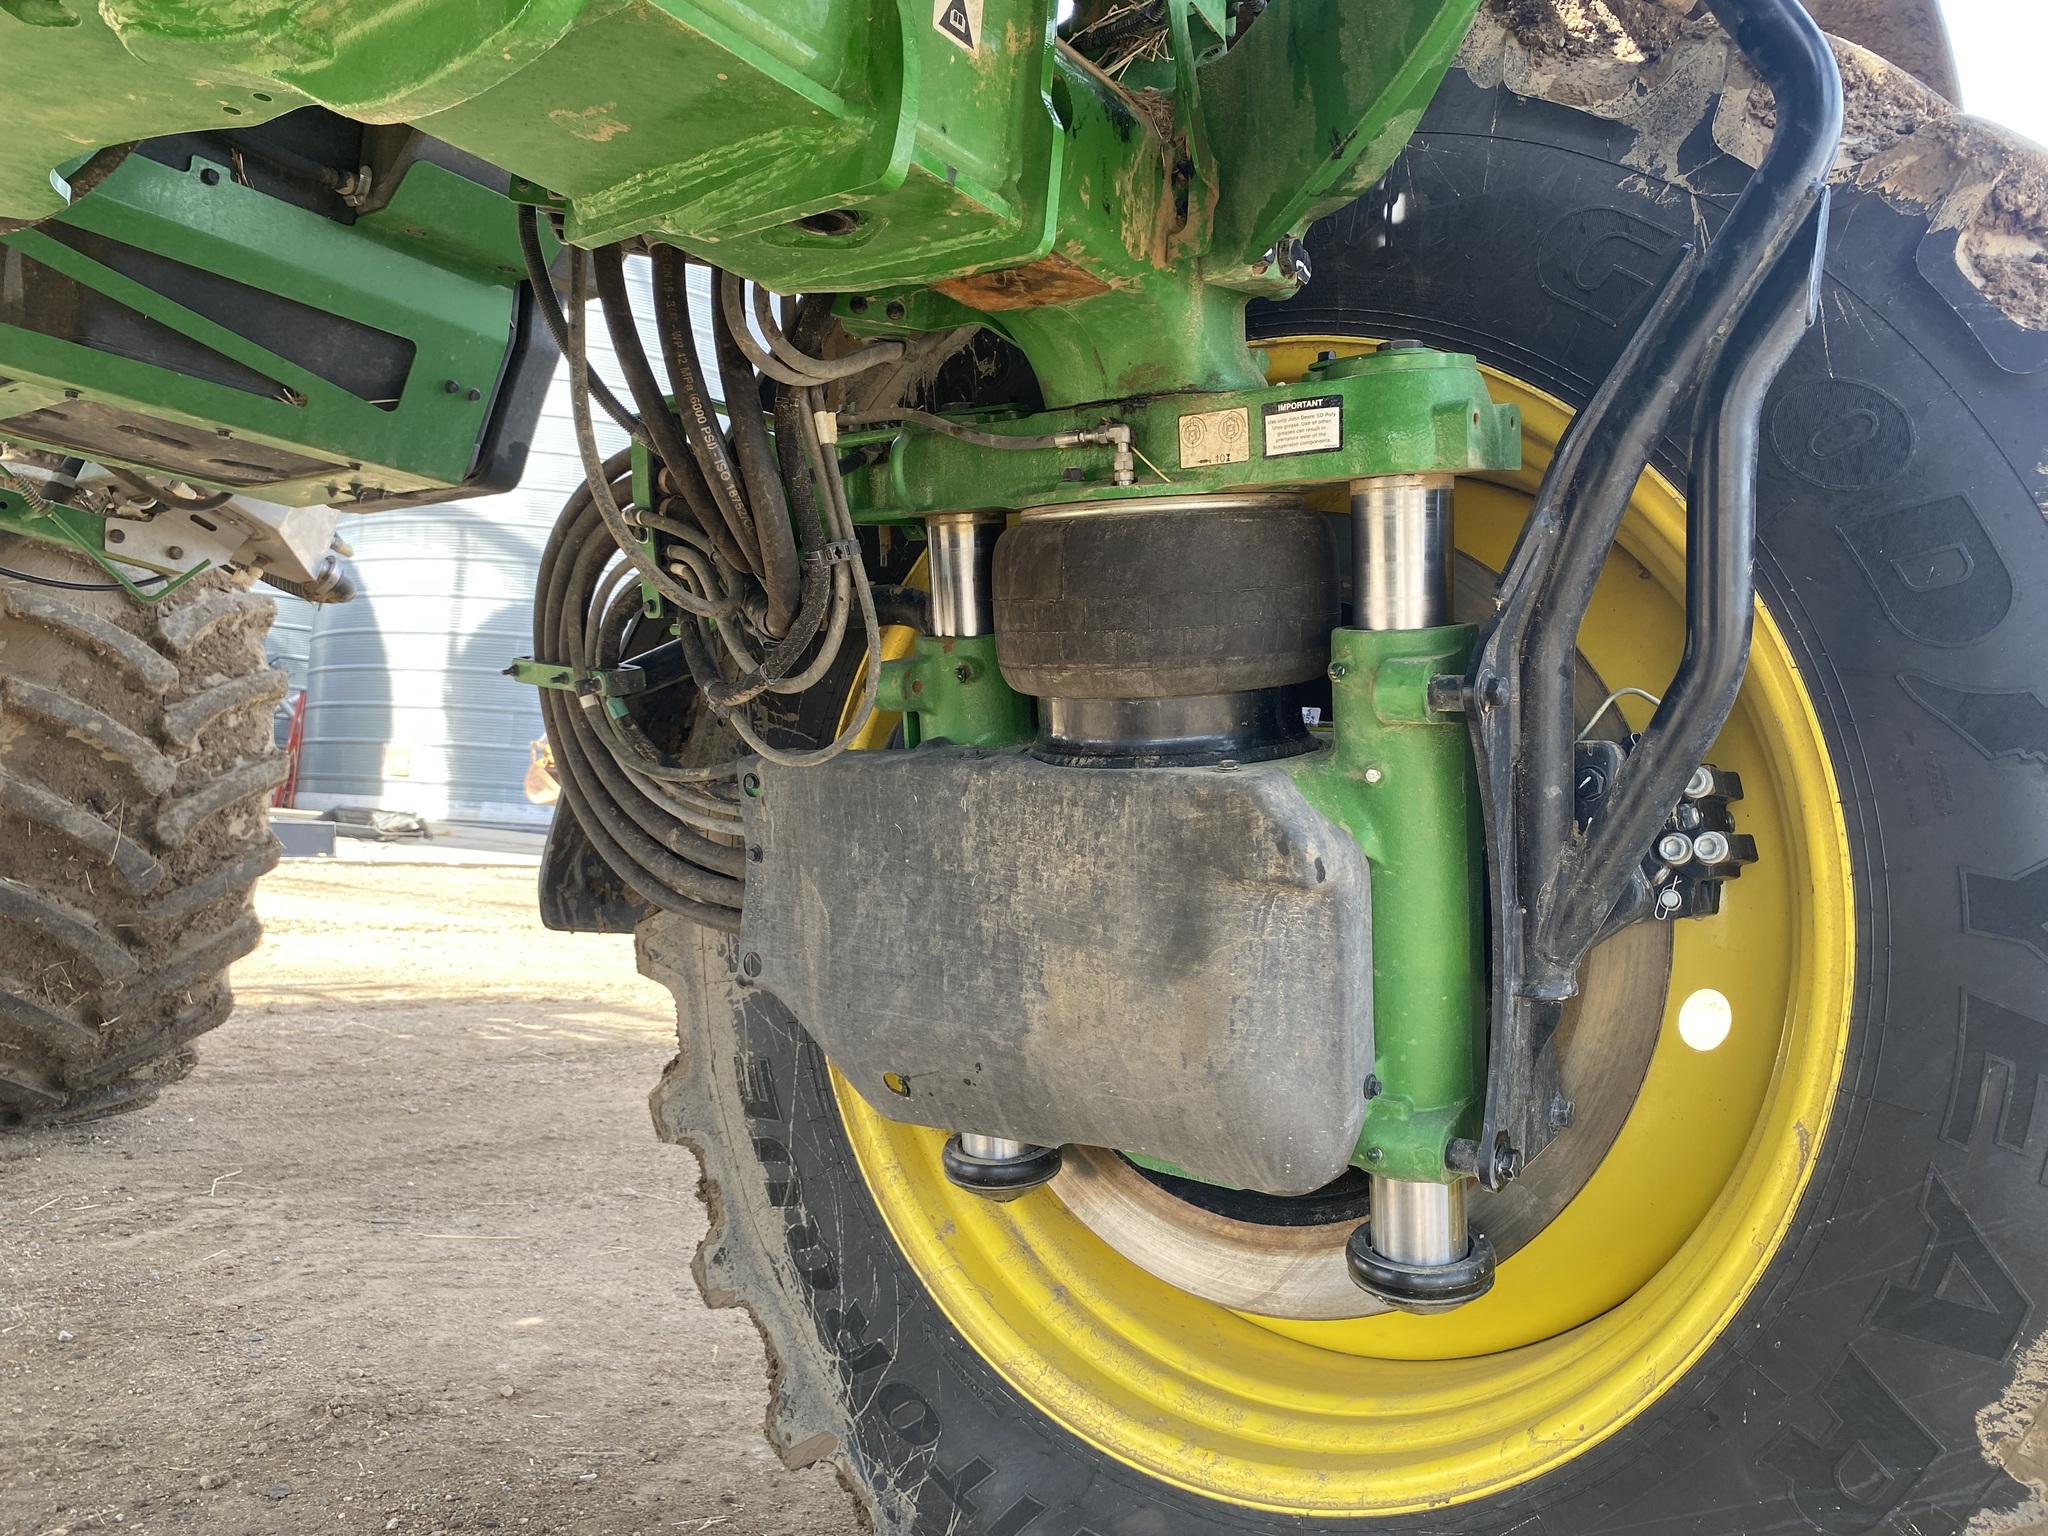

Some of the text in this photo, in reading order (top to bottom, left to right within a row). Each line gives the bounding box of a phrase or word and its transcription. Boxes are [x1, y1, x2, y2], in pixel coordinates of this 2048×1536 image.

[671, 330, 684, 349] WP
[677, 351, 688, 364] 42
[680, 366, 694, 392] MPa
[689, 393, 707, 425] (6000
[1277, 399, 1323, 411] IMPORTANT
[701, 426, 718, 451] PSI)
[1273, 441, 1299, 449] suspension
[1276, 435, 1298, 443] premature
[1215, 454, 1225, 463] 10
[714, 459, 731, 481] ISO
[941, 1351, 985, 1400] ROTATION
